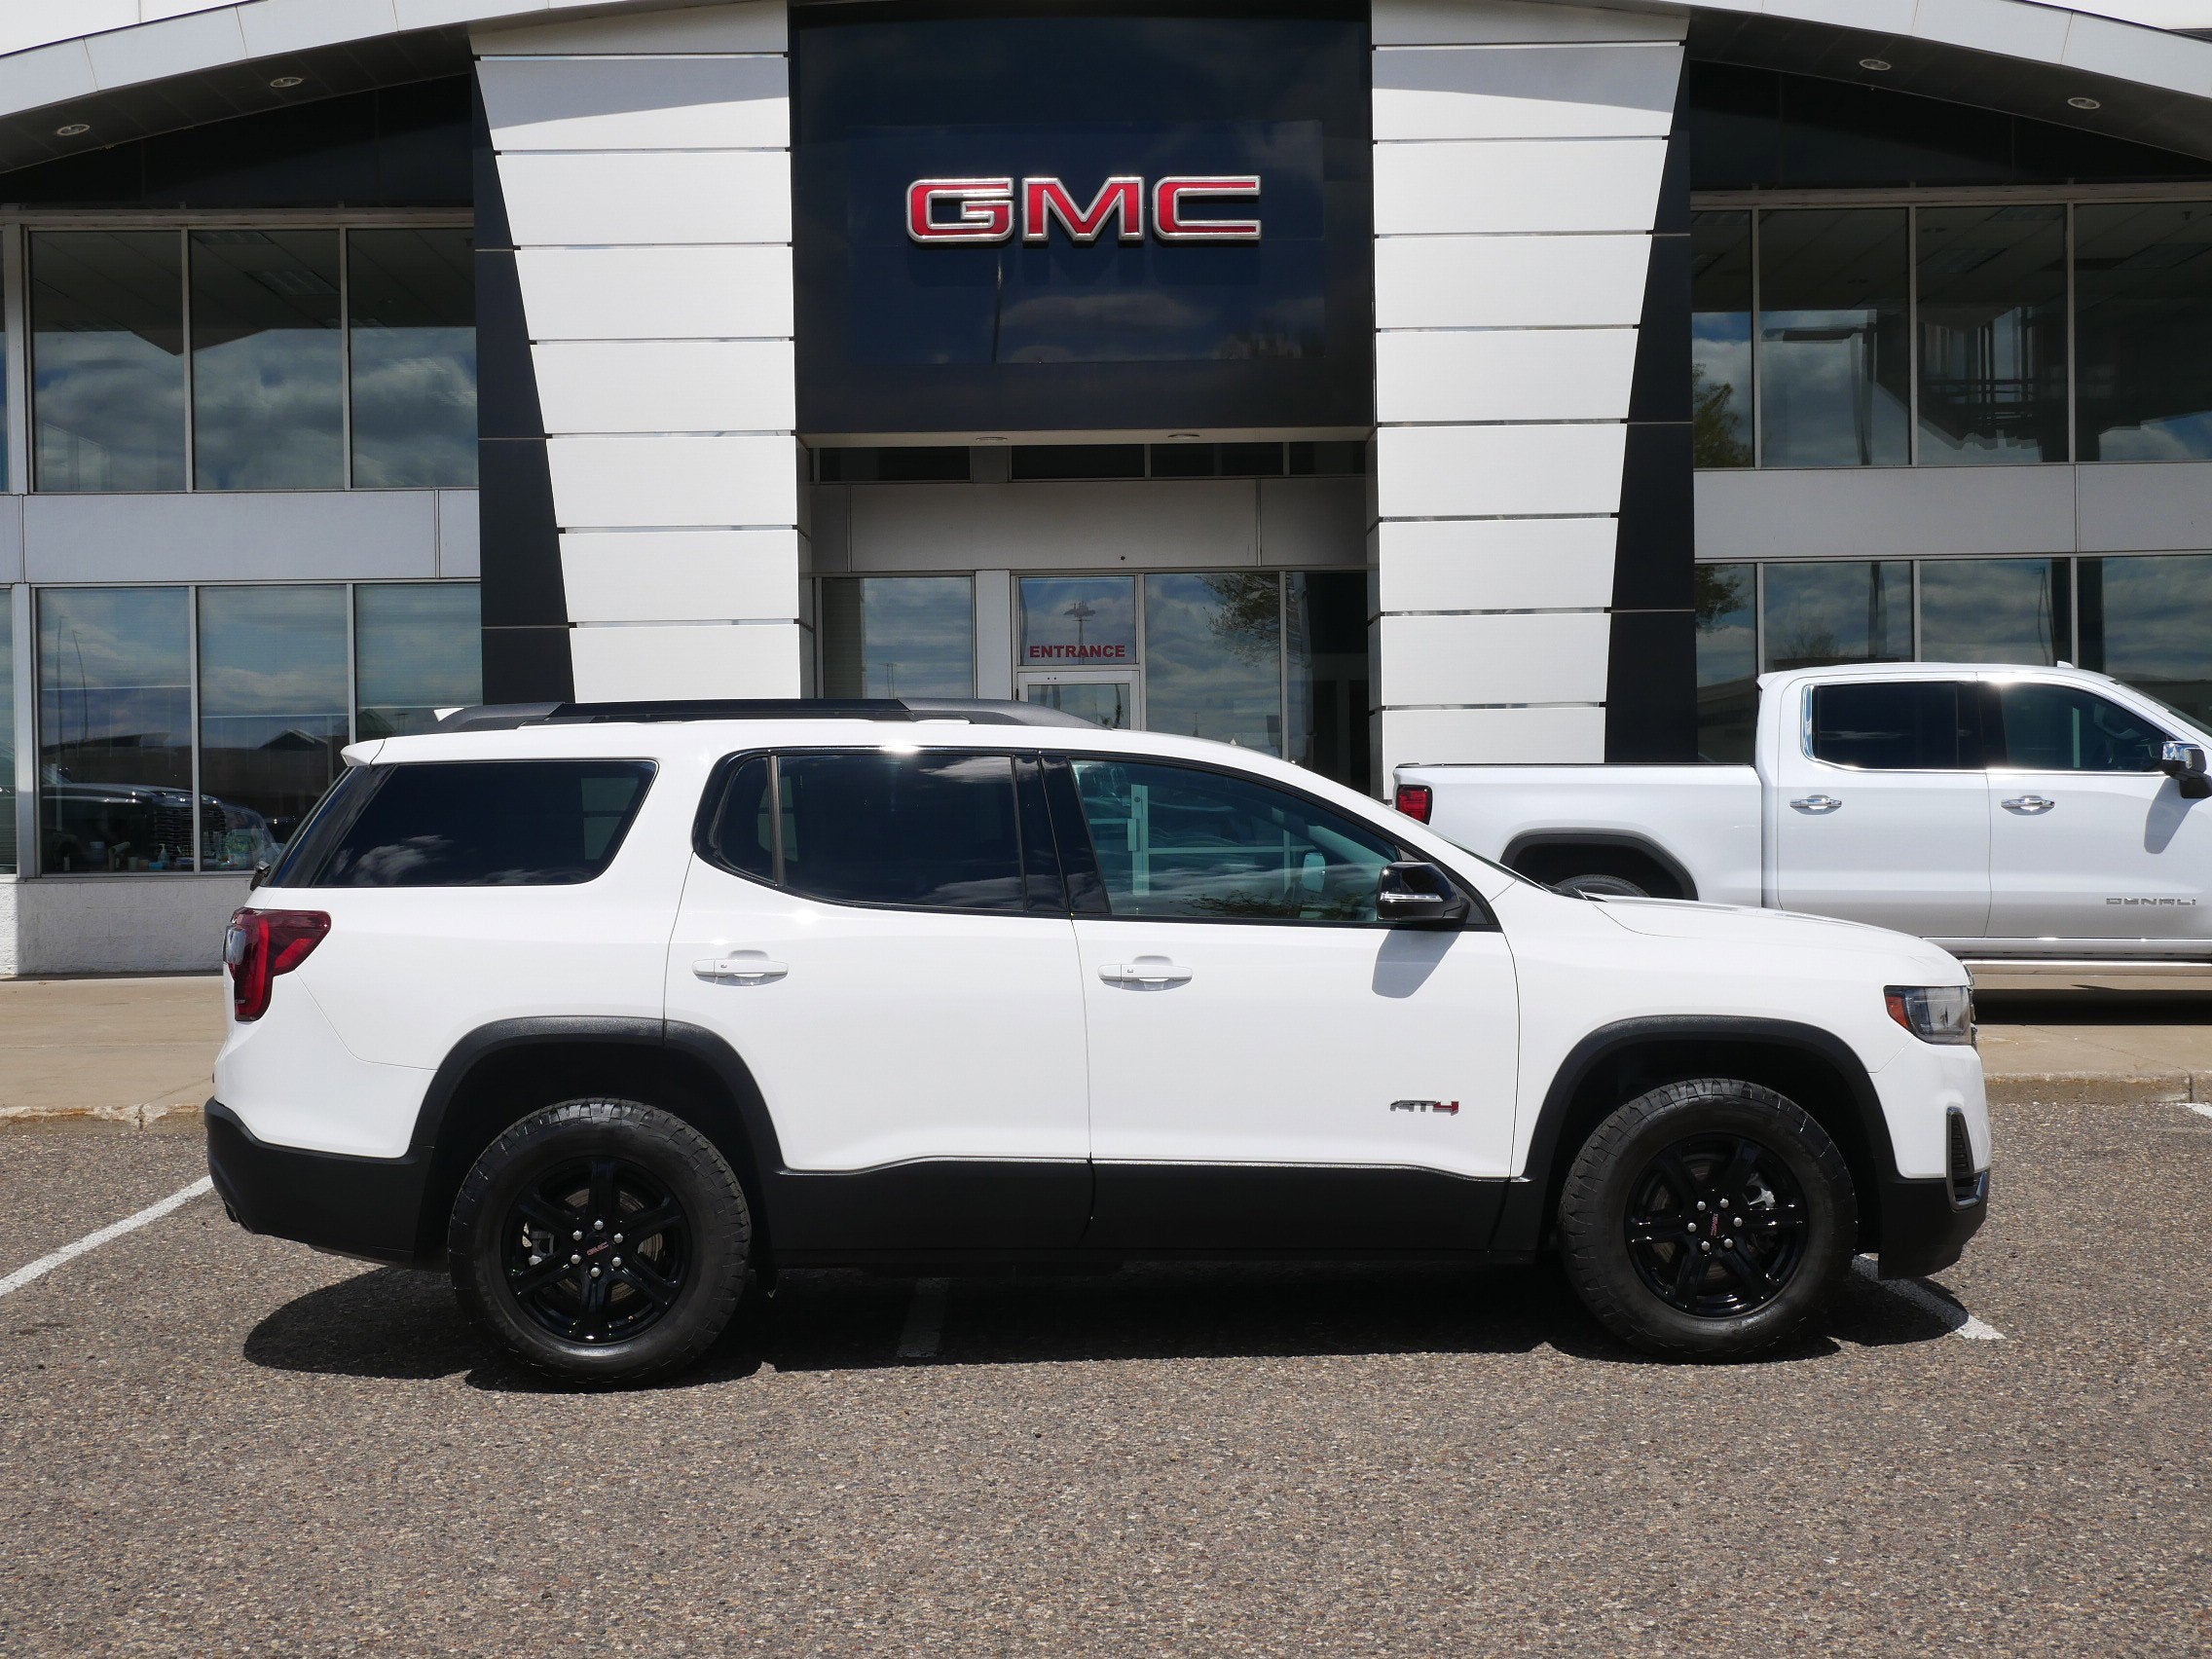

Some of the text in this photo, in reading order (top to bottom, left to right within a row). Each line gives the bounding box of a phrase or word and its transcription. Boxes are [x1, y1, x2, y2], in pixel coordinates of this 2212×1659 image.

[905, 175, 1262, 242] GMC
[1029, 645, 1125, 658] ENTRANCE
[2105, 897, 2196, 906] DENALI
[1389, 1099, 1459, 1116] AT4
